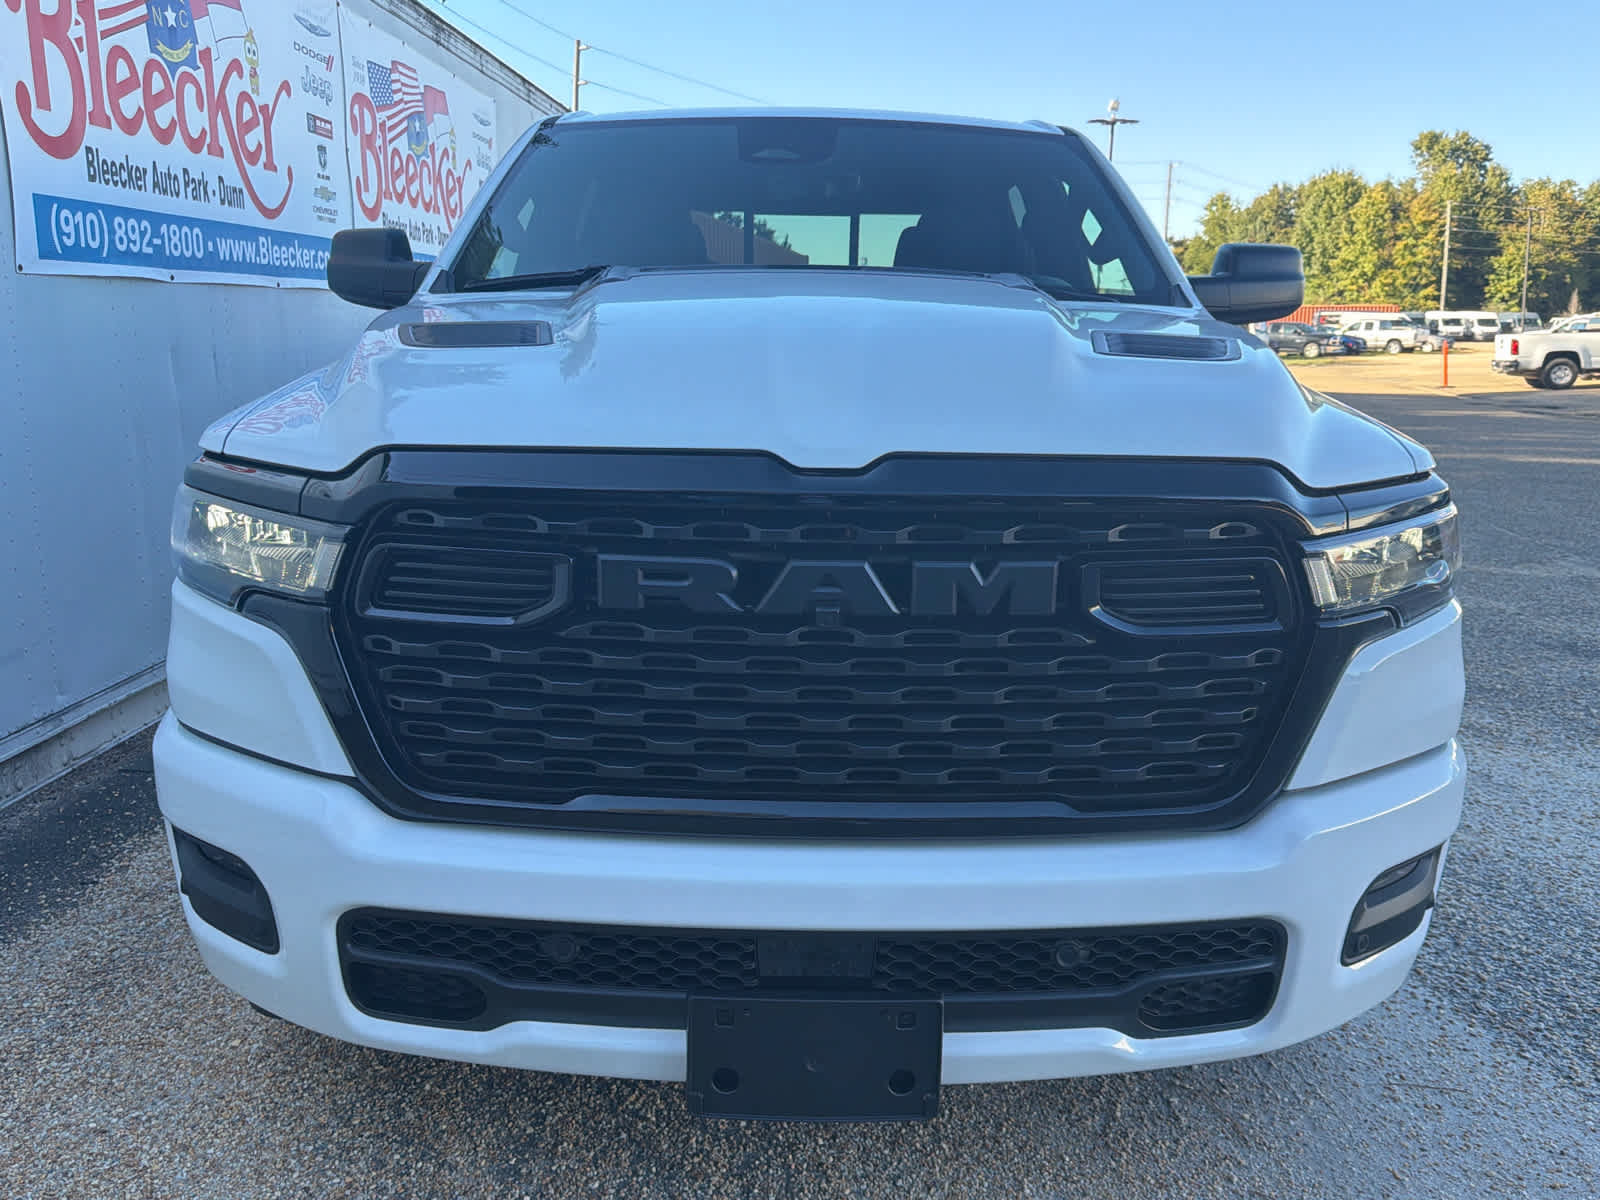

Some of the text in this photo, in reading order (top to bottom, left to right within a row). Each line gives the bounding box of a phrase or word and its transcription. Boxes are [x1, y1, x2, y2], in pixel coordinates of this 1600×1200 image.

[152, 6, 189, 28] N C
[294, 41, 329, 65] DODGE
[4, 0, 293, 220] Bleecker
[301, 65, 333, 106] Jeep
[85, 145, 245, 209] Bleecker Auto Park Dunn
[350, 92, 472, 232] Bleecker
[51, 203, 109, 258] (910)
[115, 216, 203, 259] 892-1800
[597, 553, 1061, 616] RAM
